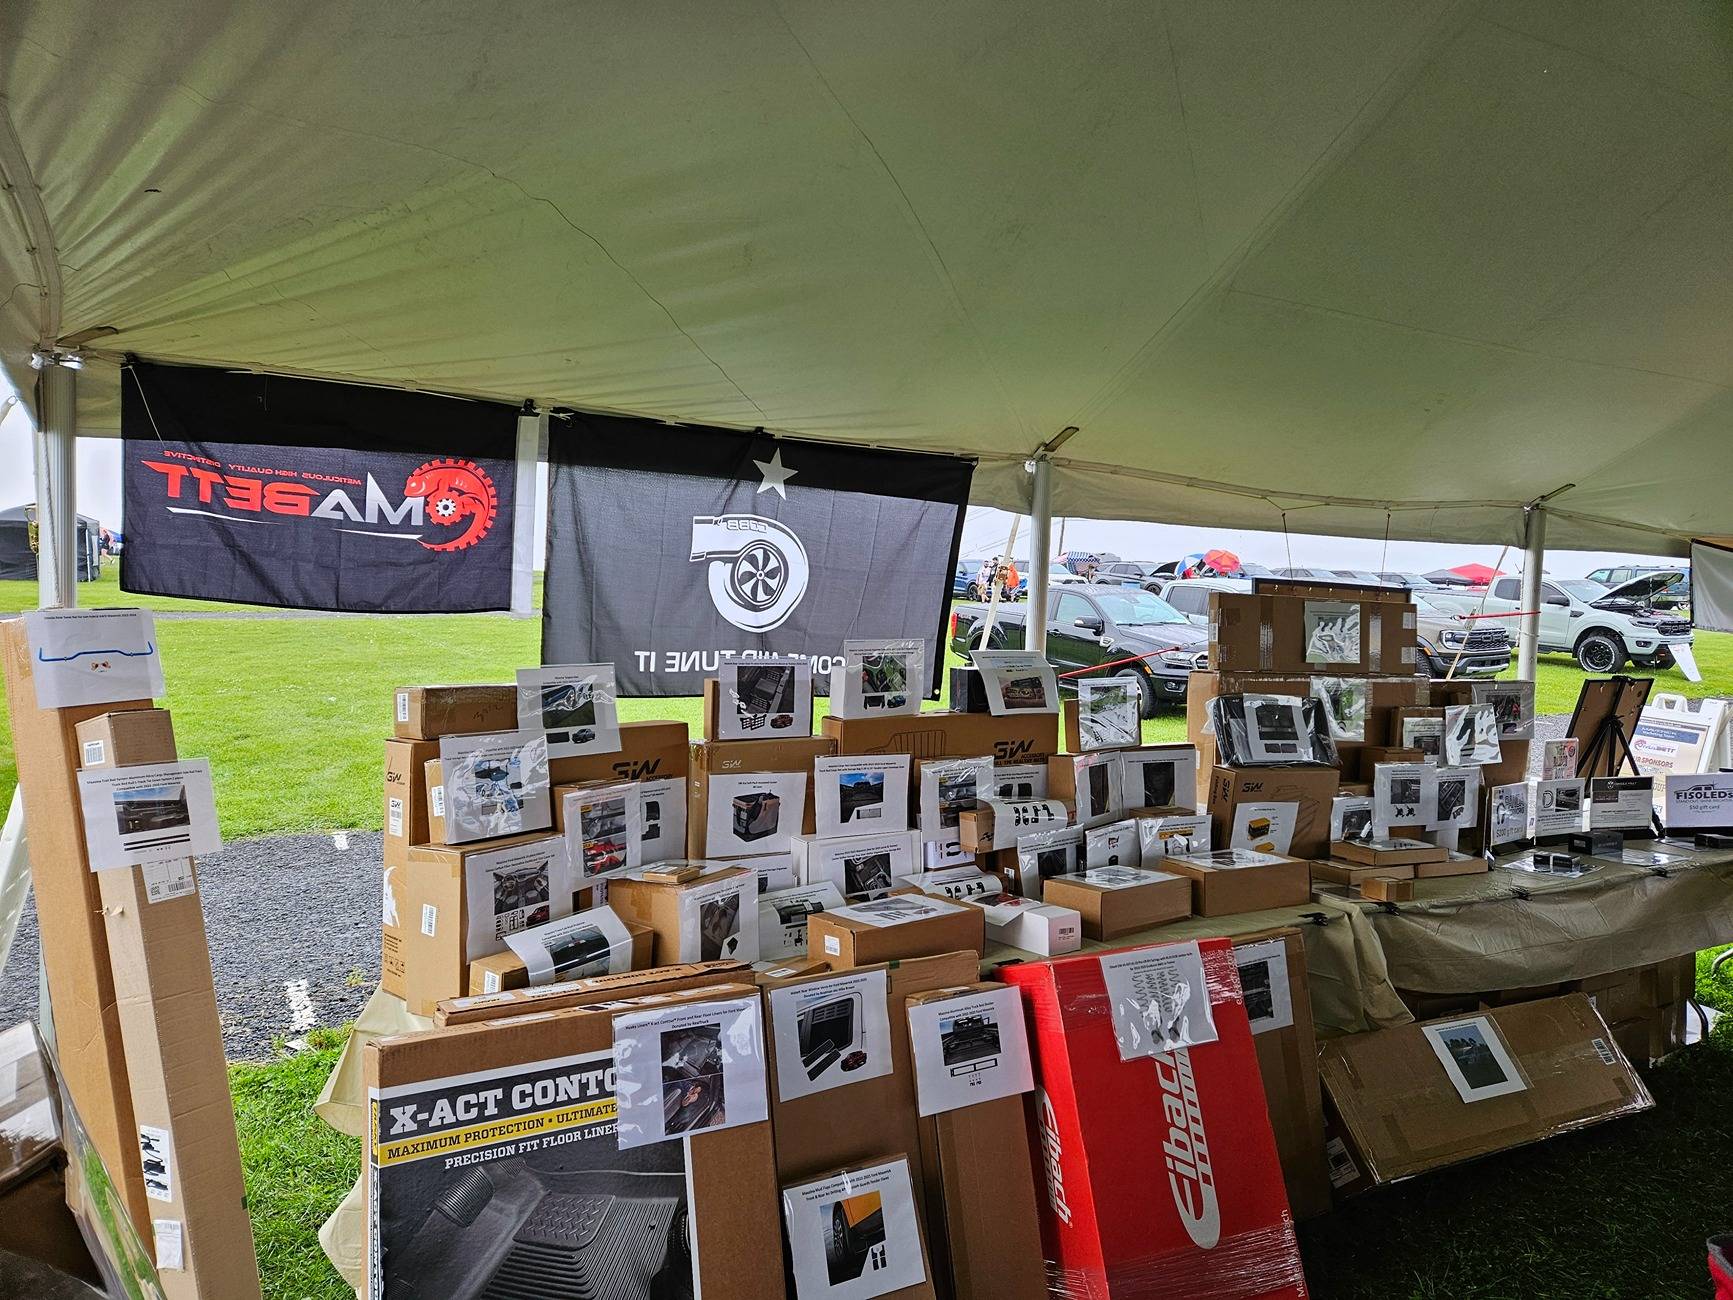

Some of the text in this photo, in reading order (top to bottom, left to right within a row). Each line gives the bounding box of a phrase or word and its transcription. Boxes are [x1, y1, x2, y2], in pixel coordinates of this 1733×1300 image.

[1642, 757, 1674, 768] SPONSORS
[388, 1104, 617, 1159] MAXIMUM PROTECTION ULTIMATE
[389, 1087, 502, 1135] X-ACT
[445, 1148, 515, 1170] PRECISION
[518, 1139, 539, 1153] FIT
[542, 1130, 581, 1146] FLOOR
[1036, 1084, 1072, 1225] Eibach
